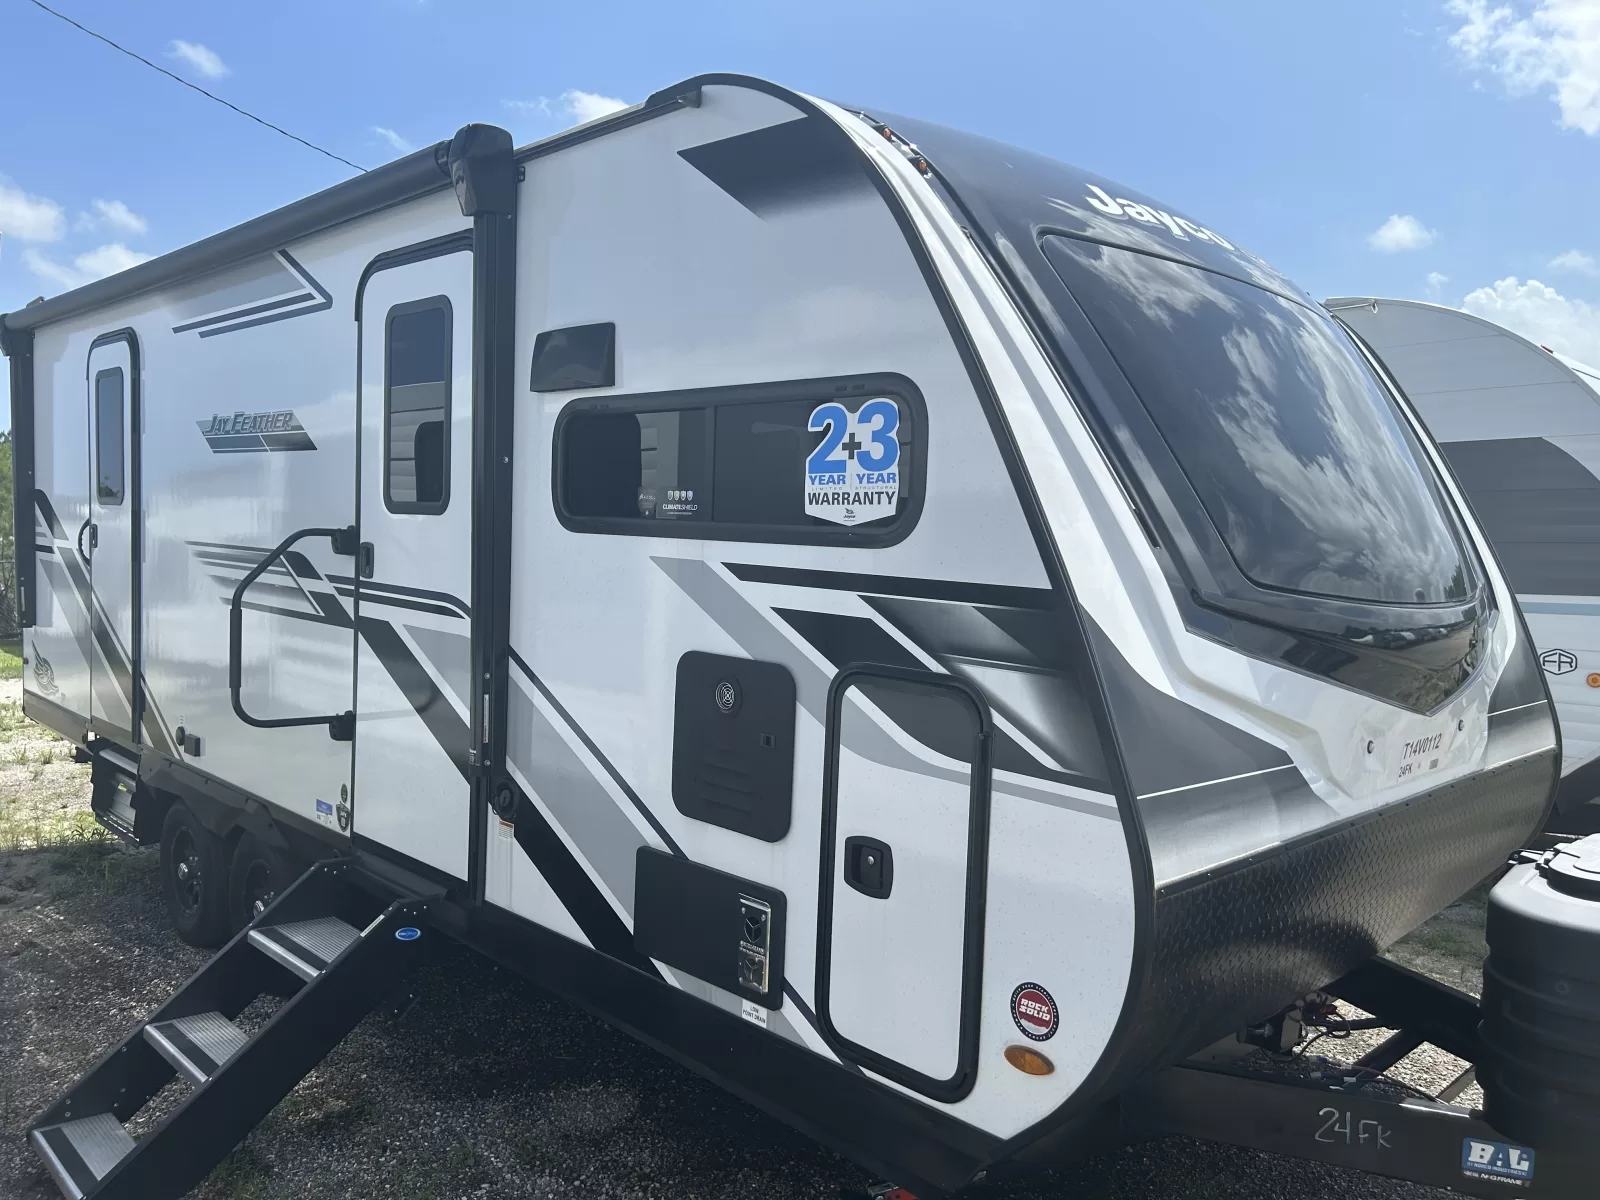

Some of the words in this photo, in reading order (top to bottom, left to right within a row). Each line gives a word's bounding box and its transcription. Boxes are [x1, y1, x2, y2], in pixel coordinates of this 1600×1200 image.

[1084, 183, 1235, 251] Jayco
[230, 410, 294, 433] FEATHER
[808, 474, 846, 486] YEAR
[856, 472, 897, 484] YEAR
[807, 491, 896, 506] WARRANTY
[1019, 1004, 1051, 1021] SOLID
[1020, 998, 1049, 1013] ROCK
